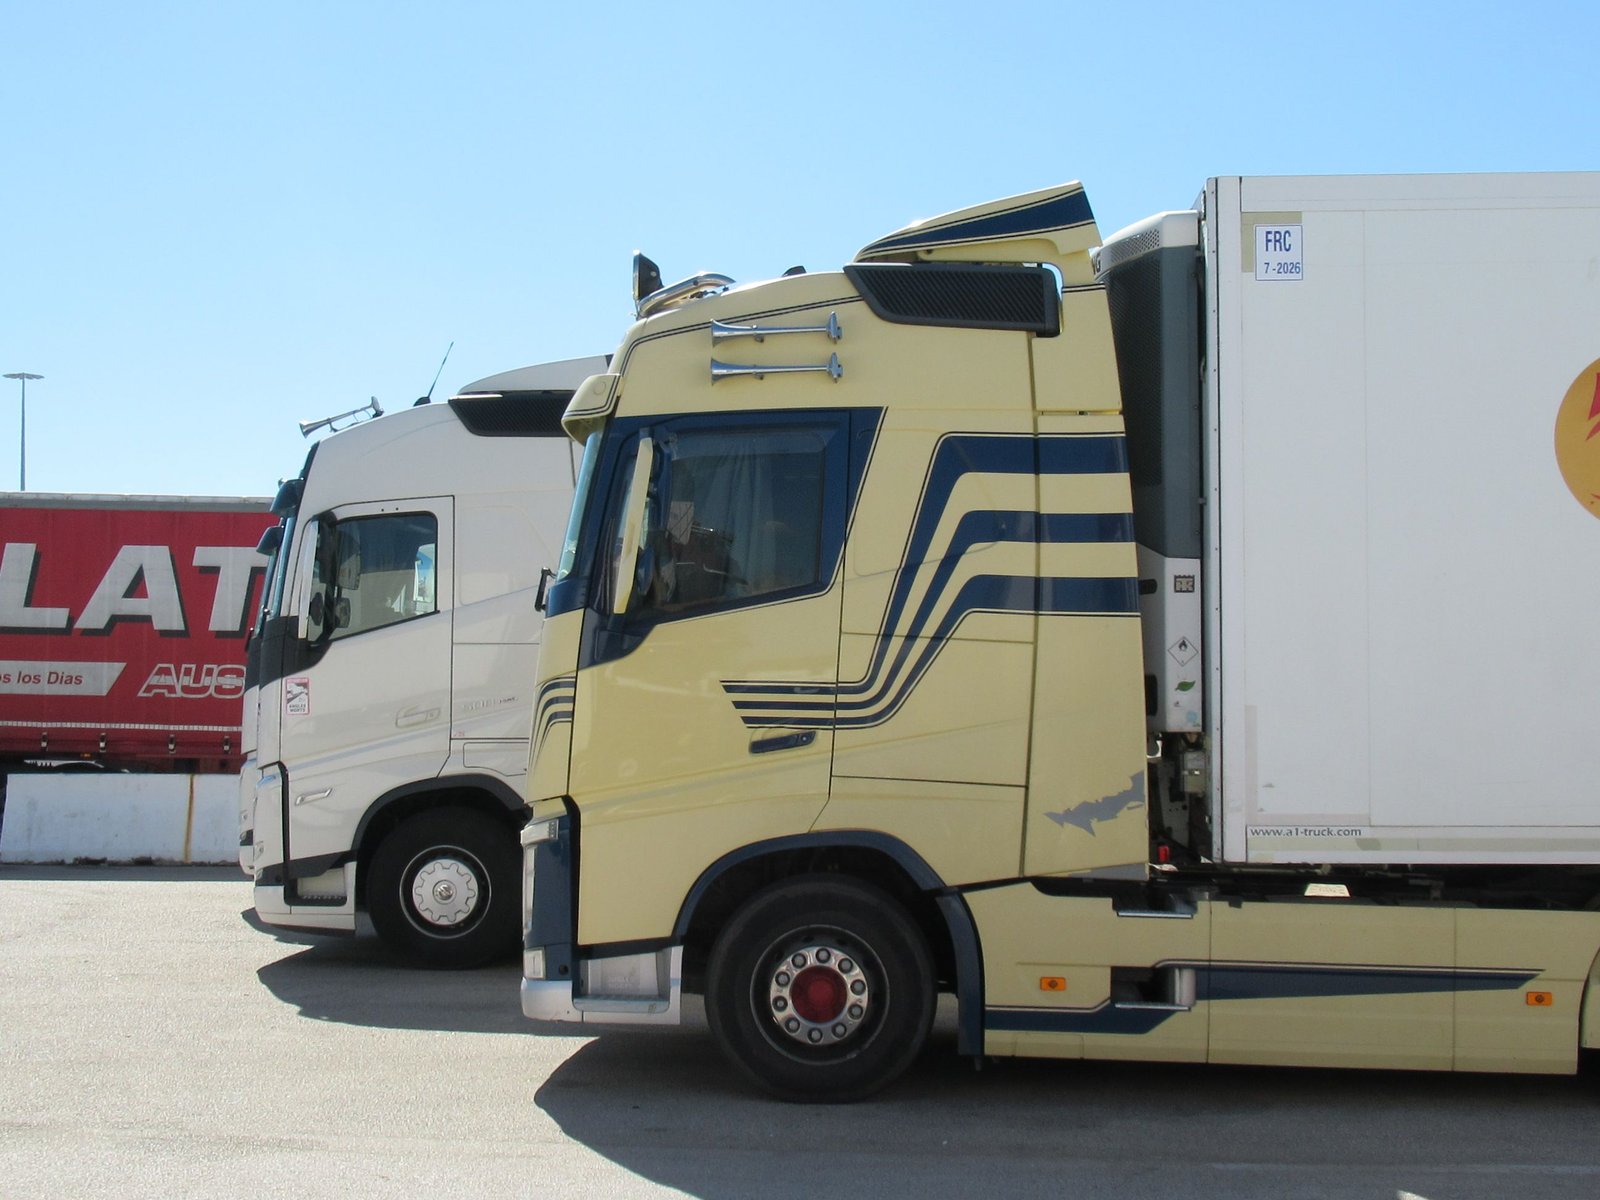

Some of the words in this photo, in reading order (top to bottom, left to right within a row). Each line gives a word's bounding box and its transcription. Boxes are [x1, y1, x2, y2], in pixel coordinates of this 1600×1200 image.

[1265, 230, 1292, 252] FRC
[0, 542, 268, 632] LAT
[17, 671, 41, 684] los
[47, 671, 83, 685] Dias
[1250, 827, 1362, 837] www.a1-truck.com
